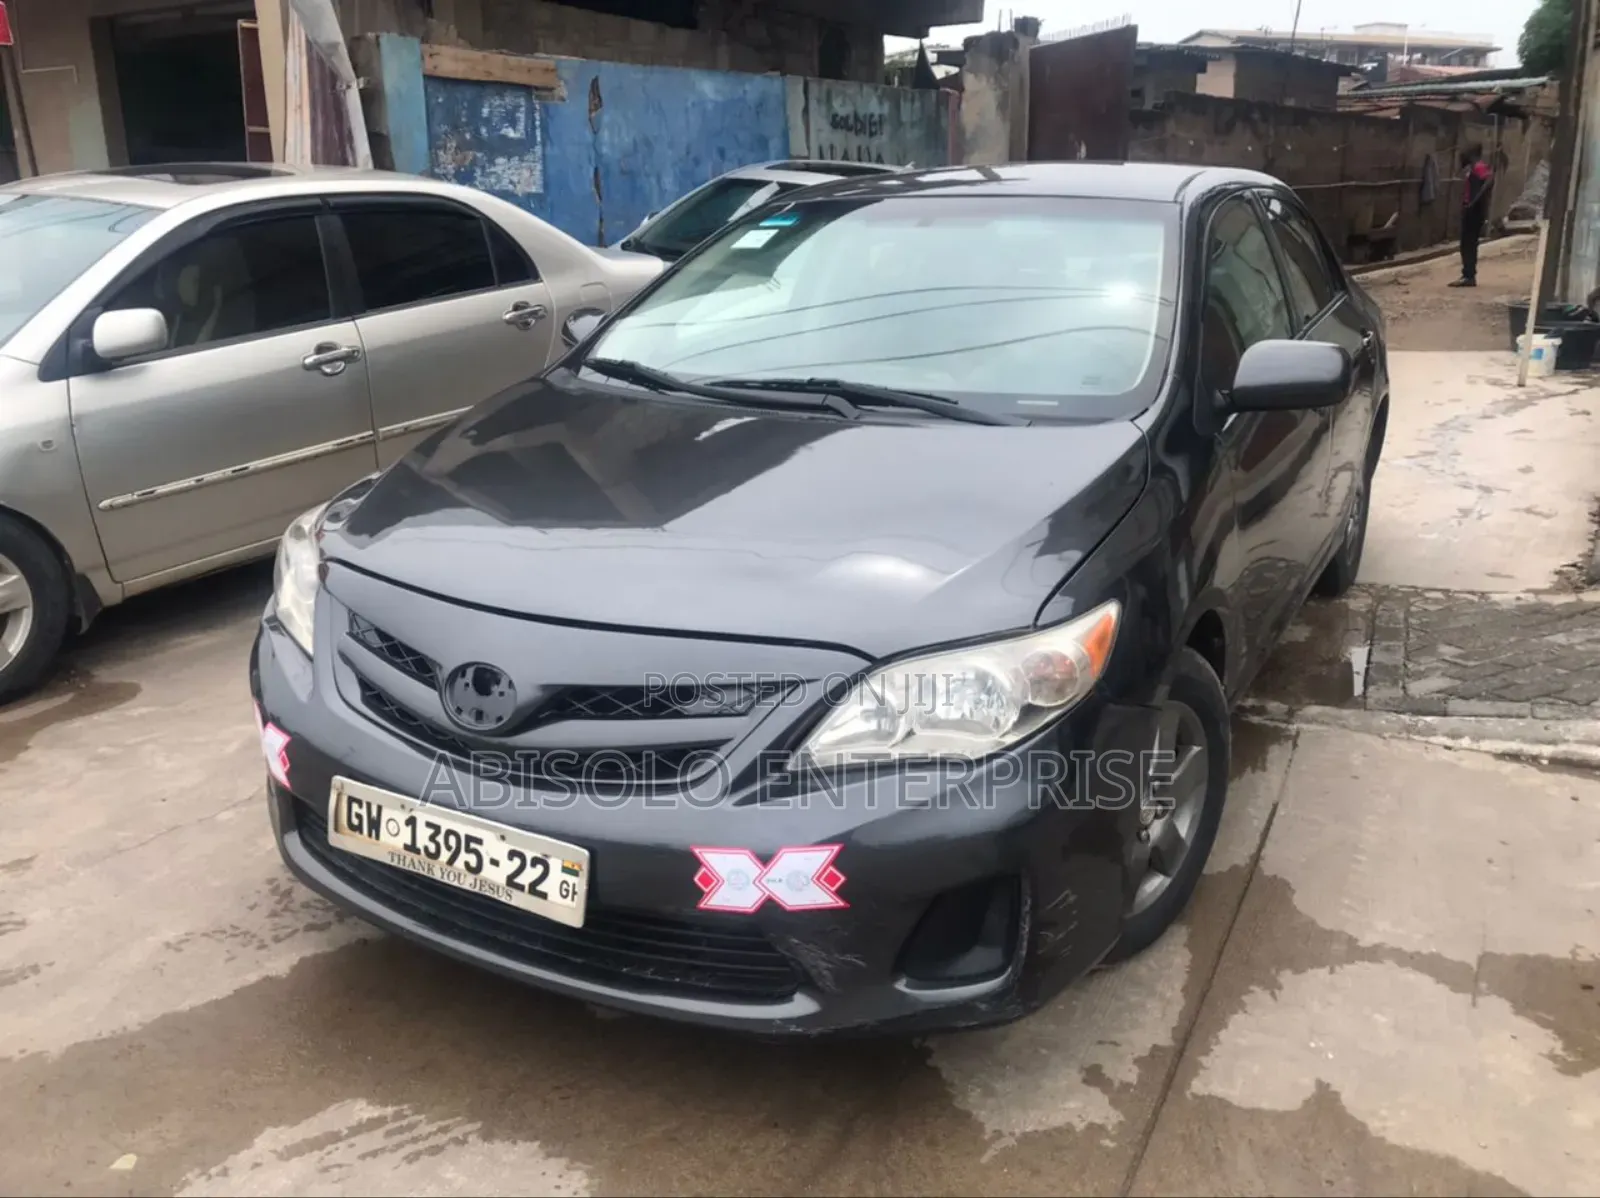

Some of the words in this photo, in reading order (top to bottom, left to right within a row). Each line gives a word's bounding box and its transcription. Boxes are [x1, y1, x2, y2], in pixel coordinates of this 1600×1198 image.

[346, 795, 383, 841] GW
[403, 815, 551, 900] 1395-22
[388, 851, 436, 876] THANK
[440, 866, 467, 886] YOU
[469, 877, 514, 902] JESUS
